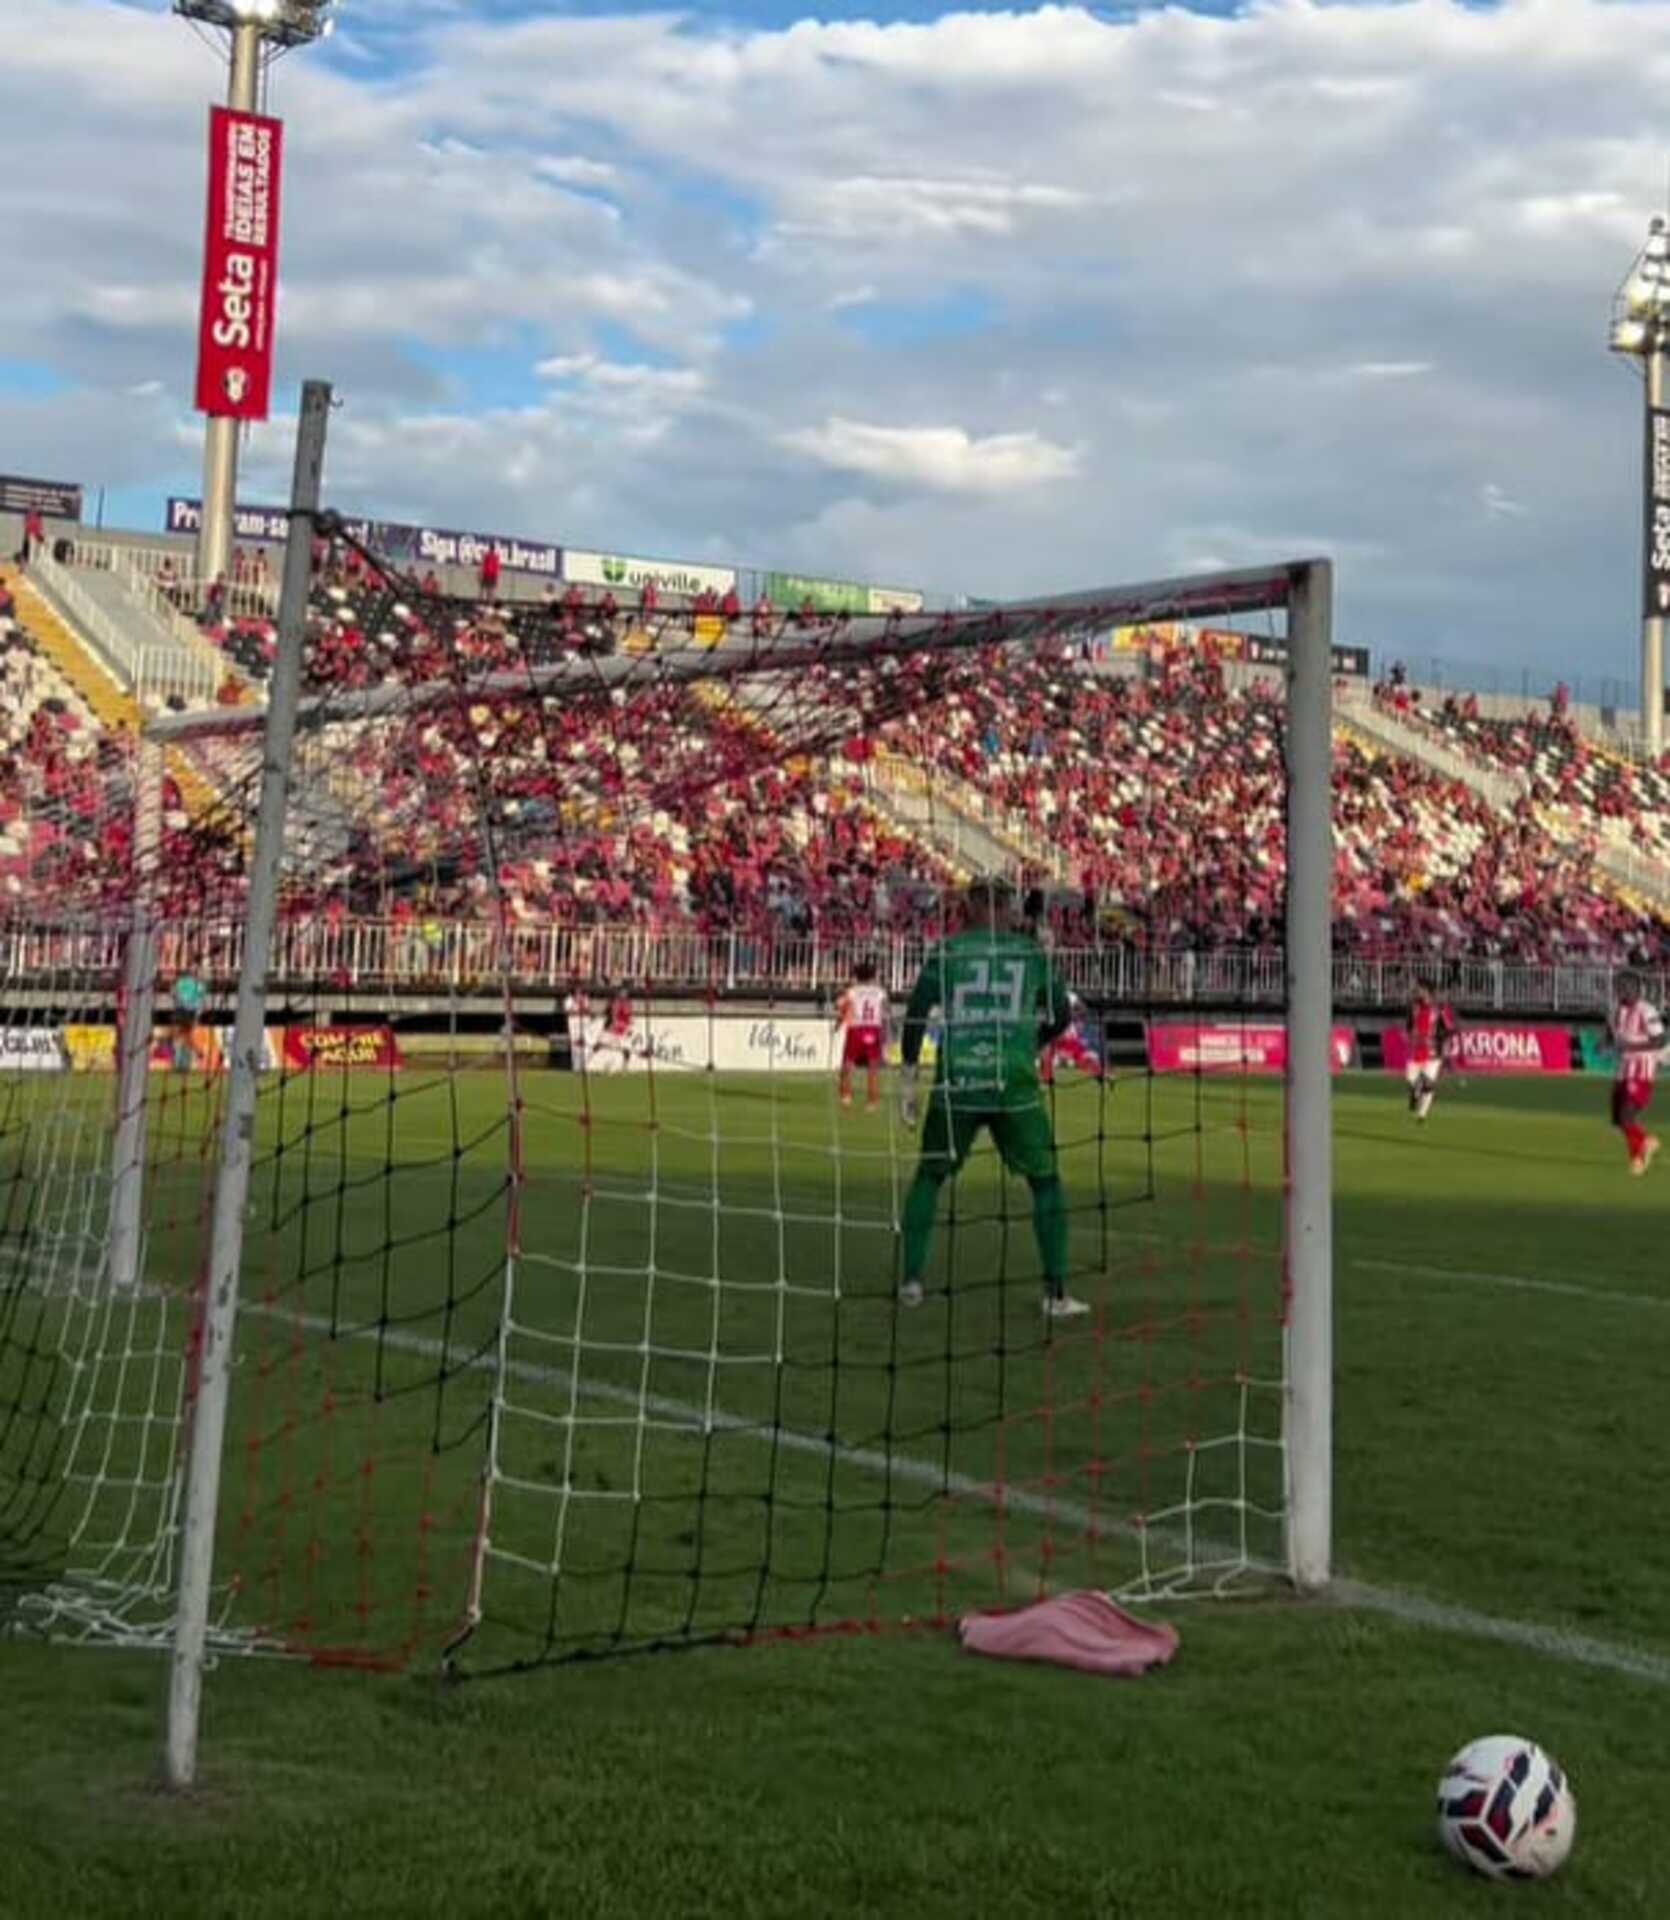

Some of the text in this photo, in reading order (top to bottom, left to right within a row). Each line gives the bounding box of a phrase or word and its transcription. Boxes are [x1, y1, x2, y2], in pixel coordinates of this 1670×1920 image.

[212, 252, 255, 349] Seta
[953, 960, 1026, 1020] 23
[1461, 1031, 1540, 1057] KRONA
